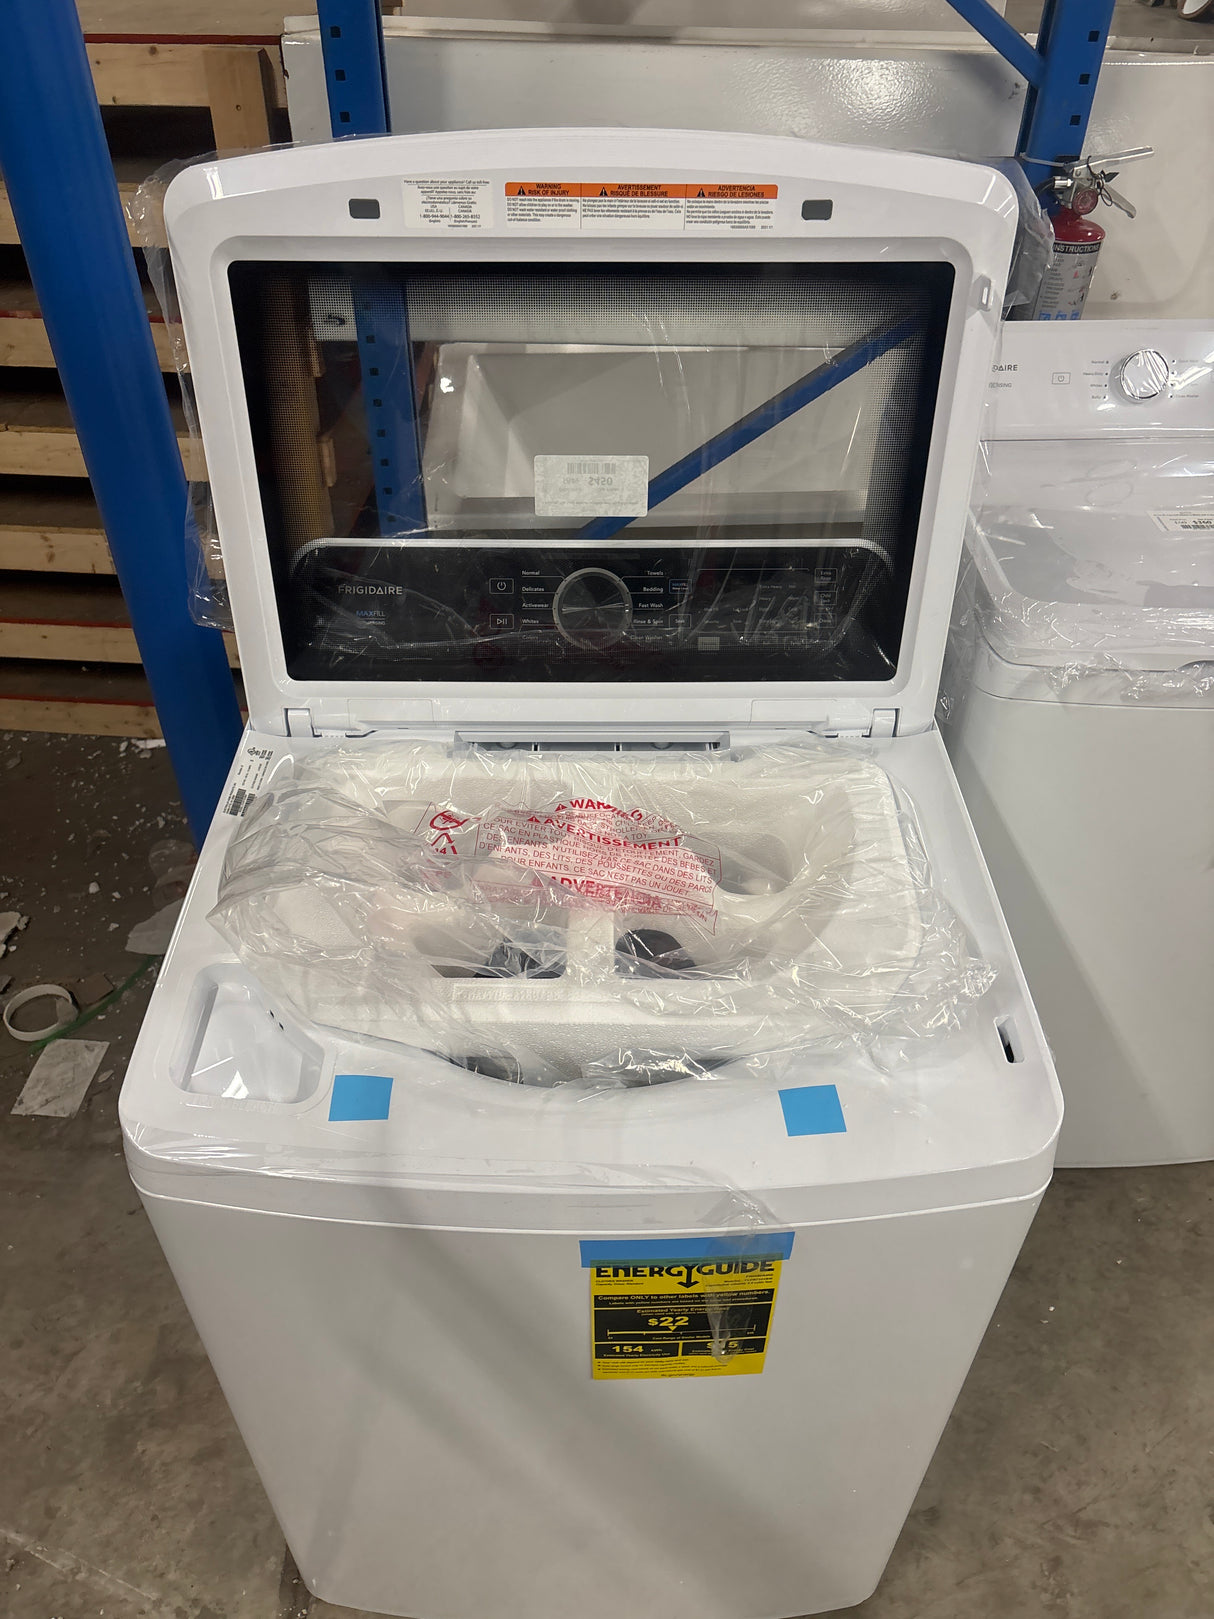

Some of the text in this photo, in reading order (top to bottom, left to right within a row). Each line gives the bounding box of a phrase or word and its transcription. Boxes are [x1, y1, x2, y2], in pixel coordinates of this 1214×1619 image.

[338, 586, 403, 594] FRIGIDAIRE
[544, 818, 682, 850] AVERTISSEMENT
[499, 825, 516, 834] SAC
[518, 829, 531, 838] EN
[662, 857, 678, 866] DES
[680, 860, 705, 873] BEBES
[708, 867, 716, 875] ET
[683, 852, 714, 867] GARDEZ
[533, 850, 551, 859] DES
[575, 857, 593, 866] DES
[597, 860, 653, 877] POUSSETTES
[669, 876, 686, 888] DES
[652, 864, 675, 876] DANS
[677, 870, 694, 880] DES
[695, 873, 713, 884] LITS
[588, 868, 606, 877] SAC
[631, 876, 647, 886] PAS
[648, 880, 660, 889] UN
[661, 883, 690, 896] JOUET
[596, 1259, 774, 1279] ENERGYGUIDE
[648, 1316, 689, 1327] $22
[612, 1345, 644, 1353] 154
[706, 1341, 739, 1349] $5
